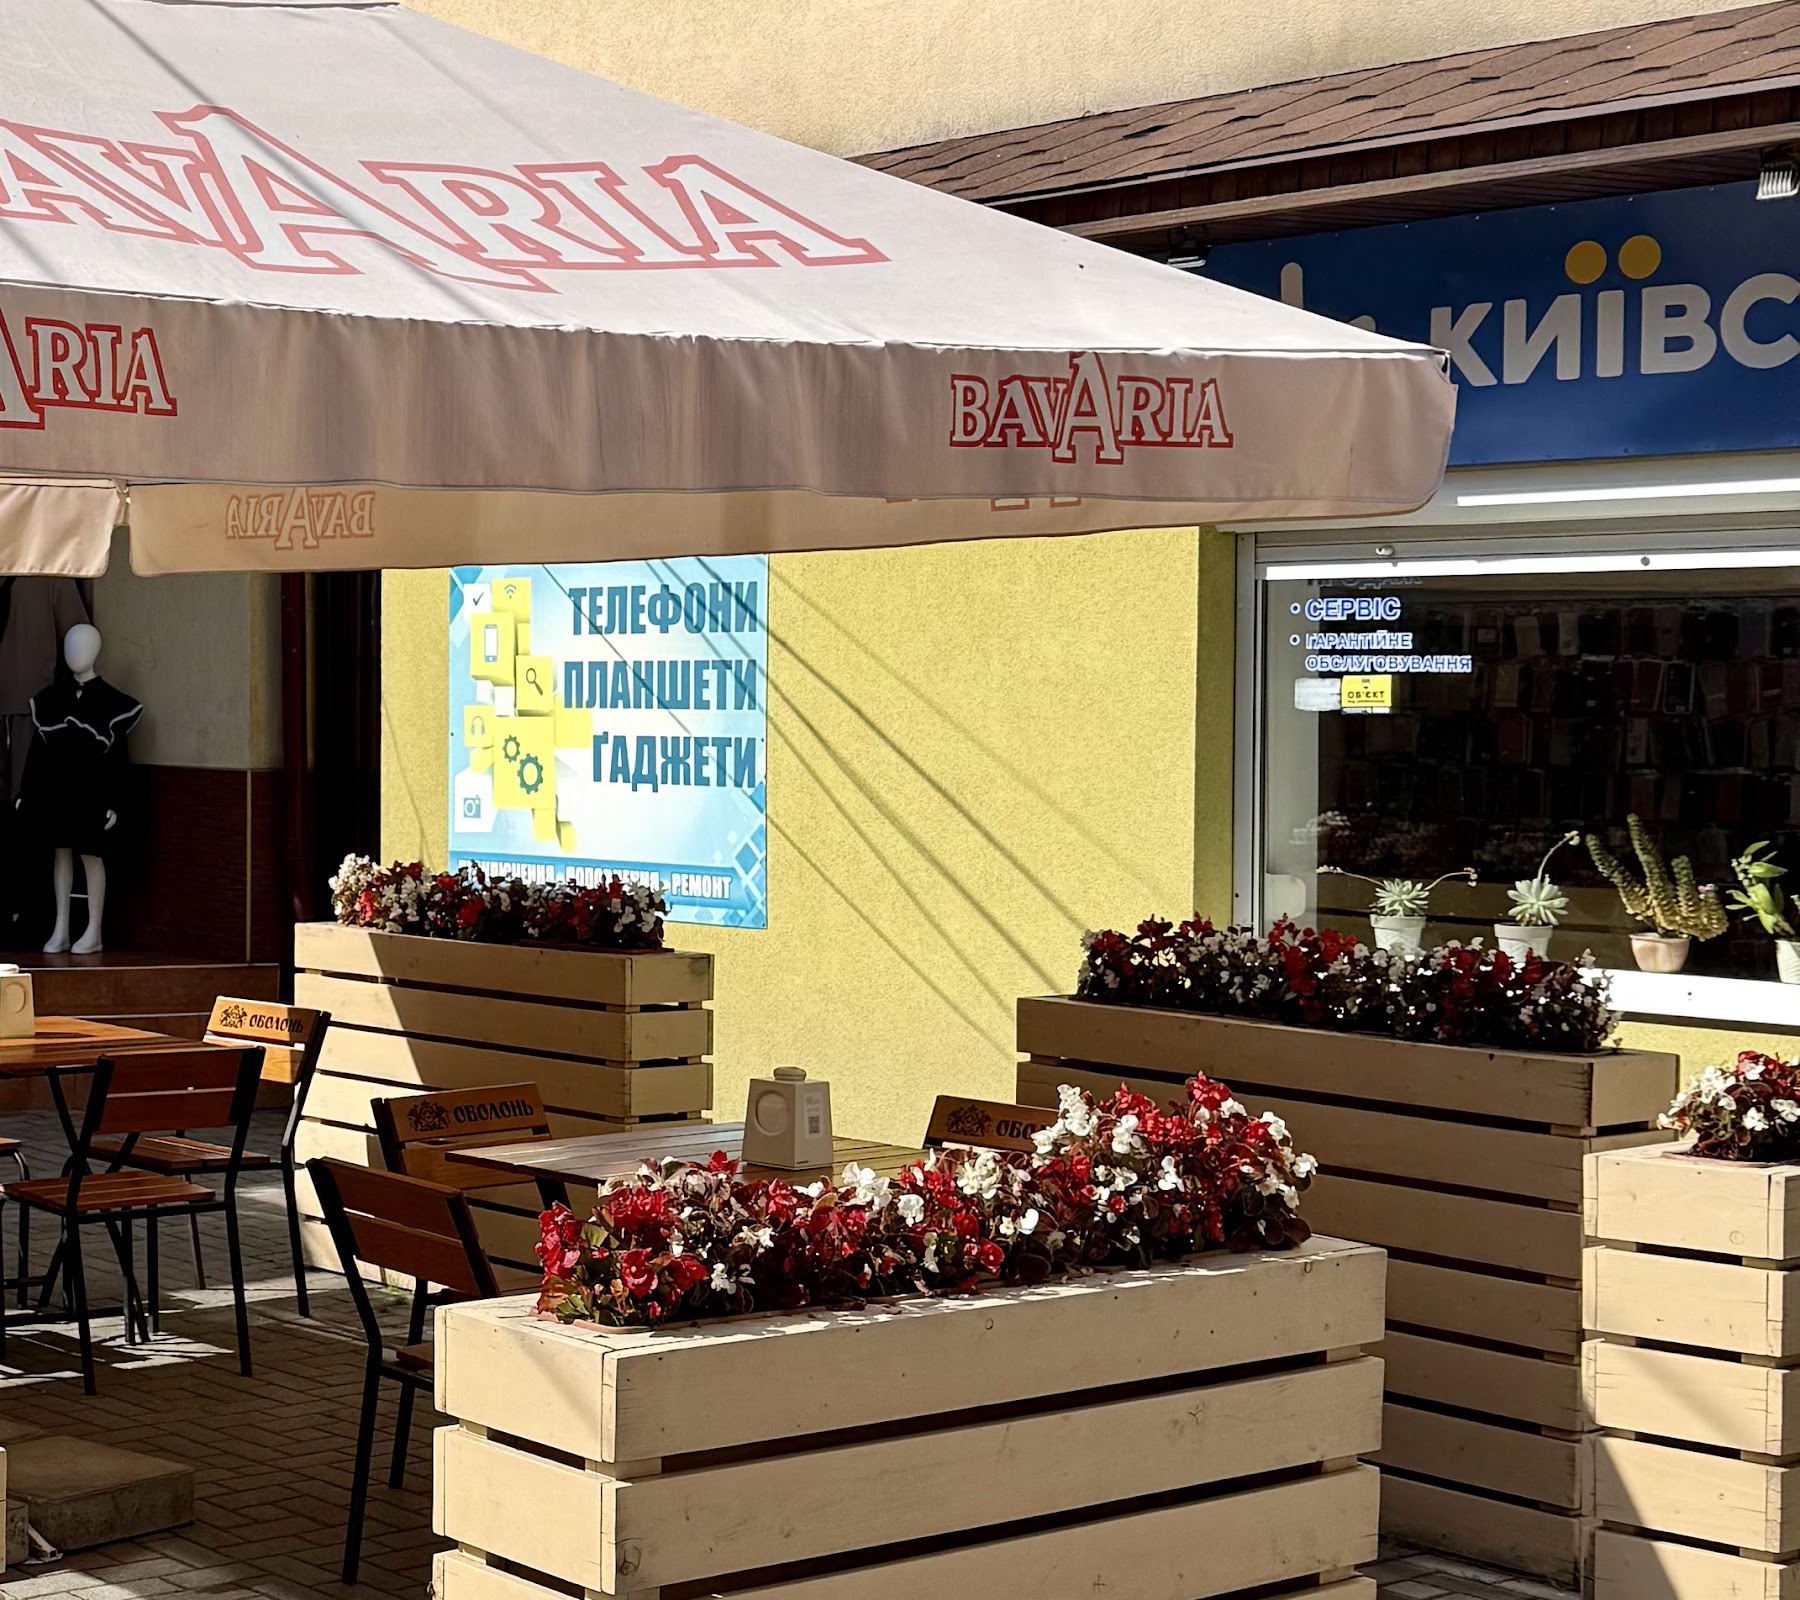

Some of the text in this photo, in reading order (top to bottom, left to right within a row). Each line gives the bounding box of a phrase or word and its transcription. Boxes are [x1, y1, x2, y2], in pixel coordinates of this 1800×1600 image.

[1430, 234, 1800, 388] КИЇВС
[949, 351, 1234, 464] BAVARIA
[568, 581, 758, 636] ТЕЛЕФОНИ
[1305, 597, 1401, 621] СЕРВІС
[564, 659, 757, 711] ПЛАНШЕТИ
[1305, 654, 1472, 673] ОБСЛУГОВУВАННЯ
[592, 731, 756, 793] ҐАДЖЕТИ
[671, 873, 732, 899] РЕМОНТ
[453, 1100, 533, 1124] ОБОЛОНЬ
